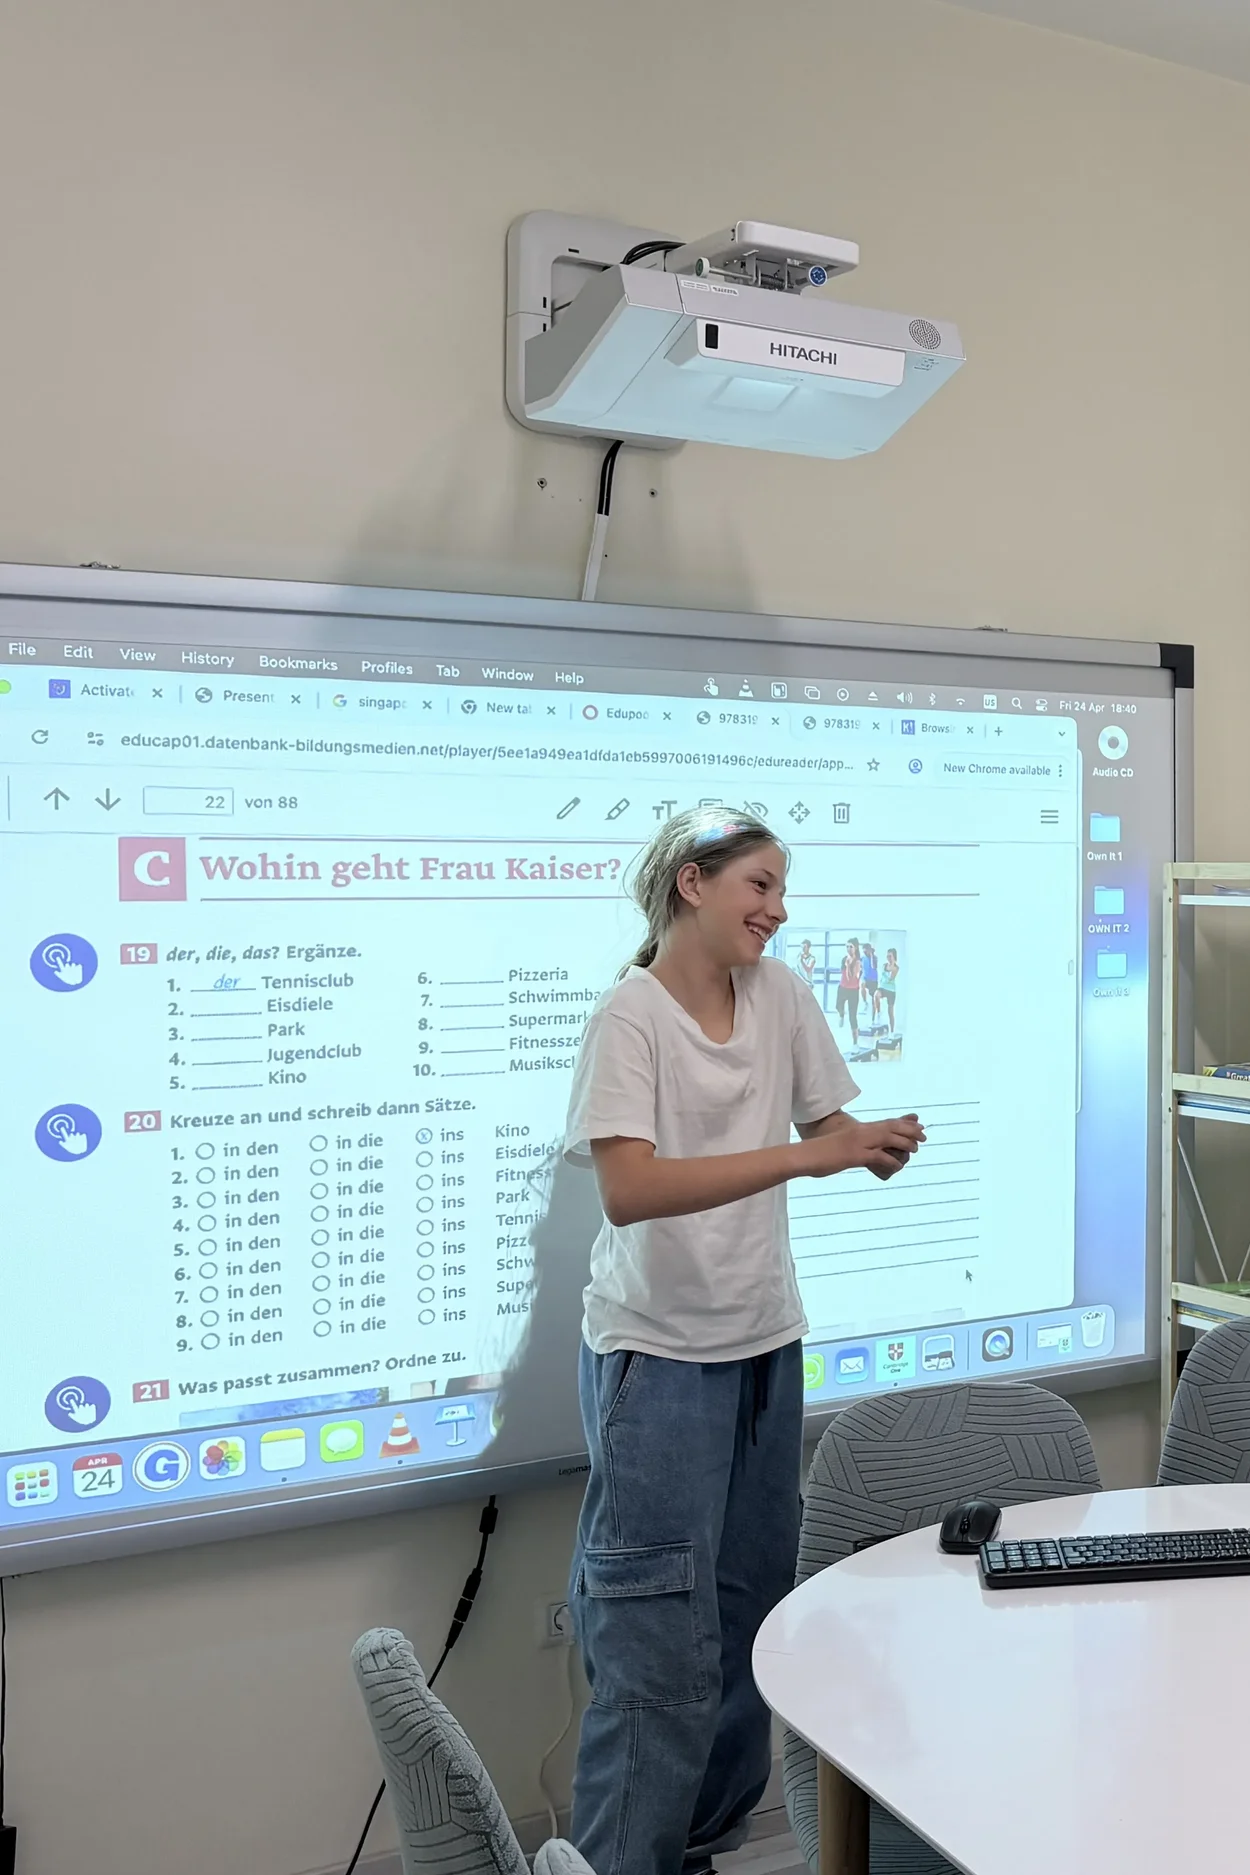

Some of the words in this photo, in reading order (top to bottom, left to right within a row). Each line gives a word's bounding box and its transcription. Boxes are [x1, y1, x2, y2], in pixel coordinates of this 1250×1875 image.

[770, 343, 836, 365] HITACHI
[9, 643, 36, 655] File
[64, 645, 93, 658] Edit
[120, 648, 156, 661] View
[182, 652, 234, 668] History
[260, 656, 338, 670] Bookmarks
[362, 661, 412, 674] Profiles
[436, 665, 459, 677] Tab
[482, 668, 533, 681] Window
[556, 672, 584, 685] Help
[487, 702, 513, 713] New
[985, 697, 995, 706] US
[1060, 701, 1071, 710] Fri
[1075, 702, 1085, 711] 24
[1089, 703, 1104, 713] Apr
[1111, 704, 1136, 713] 18:40
[944, 763, 965, 772] New
[969, 764, 1006, 774] Chrome
[1009, 766, 1050, 775] available
[1093, 768, 1118, 777] Audio
[1120, 768, 1133, 777] CD
[205, 796, 224, 808] 22
[245, 799, 272, 808] von
[278, 796, 297, 808] 88
[1087, 852, 1107, 860] Own
[134, 851, 170, 886] C
[199, 853, 321, 880] Wohin
[331, 853, 410, 887] geht
[420, 858, 495, 880] Frau
[505, 855, 621, 880] Kaiser?
[1088, 925, 1110, 933] OWN
[1124, 924, 1129, 932] 2
[127, 946, 150, 963] 19
[166, 947, 200, 964] der,
[206, 945, 236, 963] die,
[243, 946, 279, 959] das?
[287, 944, 361, 962] Ergänze.
[167, 979, 180, 992] 1.
[213, 974, 241, 989] der
[261, 973, 353, 989] Tennisclub
[418, 972, 432, 984] 6.
[509, 967, 568, 981] Pizzeria
[168, 1003, 184, 1015] 2.
[268, 997, 333, 1012] Eisdiele
[421, 994, 432, 1006] 7.
[169, 1027, 184, 1040] 3.
[268, 1022, 305, 1037] Park
[418, 1018, 433, 1030] 8.
[169, 1053, 185, 1065] 4.
[267, 1044, 361, 1064] Jugendclub
[419, 1042, 433, 1054] 9.
[170, 1076, 185, 1089] 5.
[269, 1069, 306, 1084] Kino
[413, 1064, 436, 1076] 10.
[129, 1114, 155, 1129] 20
[171, 1115, 234, 1128] Kreuze
[241, 1113, 261, 1124] an
[268, 1107, 301, 1122] und
[308, 1103, 371, 1120] schreib
[377, 1102, 419, 1115] dann
[425, 1098, 475, 1112] Sätze.
[171, 1148, 184, 1160] 1.
[223, 1143, 239, 1156] in
[247, 1142, 278, 1156] den
[336, 1135, 351, 1149] in
[358, 1133, 383, 1148] die
[440, 1128, 464, 1142] ins
[496, 1124, 529, 1137] Kino
[172, 1172, 188, 1184] 2.
[224, 1166, 240, 1180] in
[247, 1165, 278, 1178] den
[337, 1158, 352, 1171] in
[358, 1156, 383, 1170] die
[441, 1150, 464, 1164] ins
[496, 1143, 555, 1160] Eisdiele
[172, 1196, 188, 1209] 3.
[225, 1191, 241, 1204] in
[248, 1189, 279, 1203] den
[337, 1182, 352, 1196] in
[359, 1179, 383, 1194] die
[442, 1173, 464, 1187] ins
[173, 1219, 189, 1232] 4.
[225, 1214, 241, 1228] in
[248, 1212, 279, 1226] den
[337, 1204, 352, 1218] in
[359, 1201, 384, 1216] die
[441, 1195, 465, 1209] ins
[496, 1187, 529, 1204] Park
[174, 1244, 189, 1256] 5.
[226, 1238, 242, 1251] in
[249, 1236, 280, 1250] den
[338, 1228, 353, 1241] in
[359, 1225, 384, 1240] die
[442, 1218, 465, 1232] ins
[175, 1268, 191, 1281] 6.
[226, 1262, 243, 1276] in
[249, 1260, 281, 1274] den
[338, 1251, 353, 1265] in
[360, 1248, 384, 1263] die
[443, 1241, 465, 1254] ins
[175, 1291, 188, 1304] 7.
[227, 1285, 243, 1298] in
[250, 1283, 281, 1296] den
[339, 1274, 353, 1287] in
[361, 1270, 385, 1285] die
[443, 1263, 465, 1276] ins
[176, 1315, 192, 1328] 8.
[228, 1309, 244, 1322] in
[250, 1306, 282, 1320] den
[339, 1297, 354, 1310] in
[361, 1294, 385, 1308] die
[443, 1286, 465, 1299] ins
[176, 1339, 193, 1352] 9.
[229, 1333, 244, 1346] in
[251, 1330, 282, 1344] den
[340, 1320, 354, 1334] in
[361, 1317, 386, 1331] die
[444, 1308, 466, 1321] ins
[140, 1383, 162, 1399] 21
[179, 1382, 217, 1395] Was
[224, 1373, 272, 1394] passt
[277, 1360, 380, 1384] zusammen?
[385, 1354, 436, 1370] Ordne
[442, 1352, 466, 1363] zu.
[144, 1450, 180, 1482] G
[82, 1469, 115, 1491] 24
